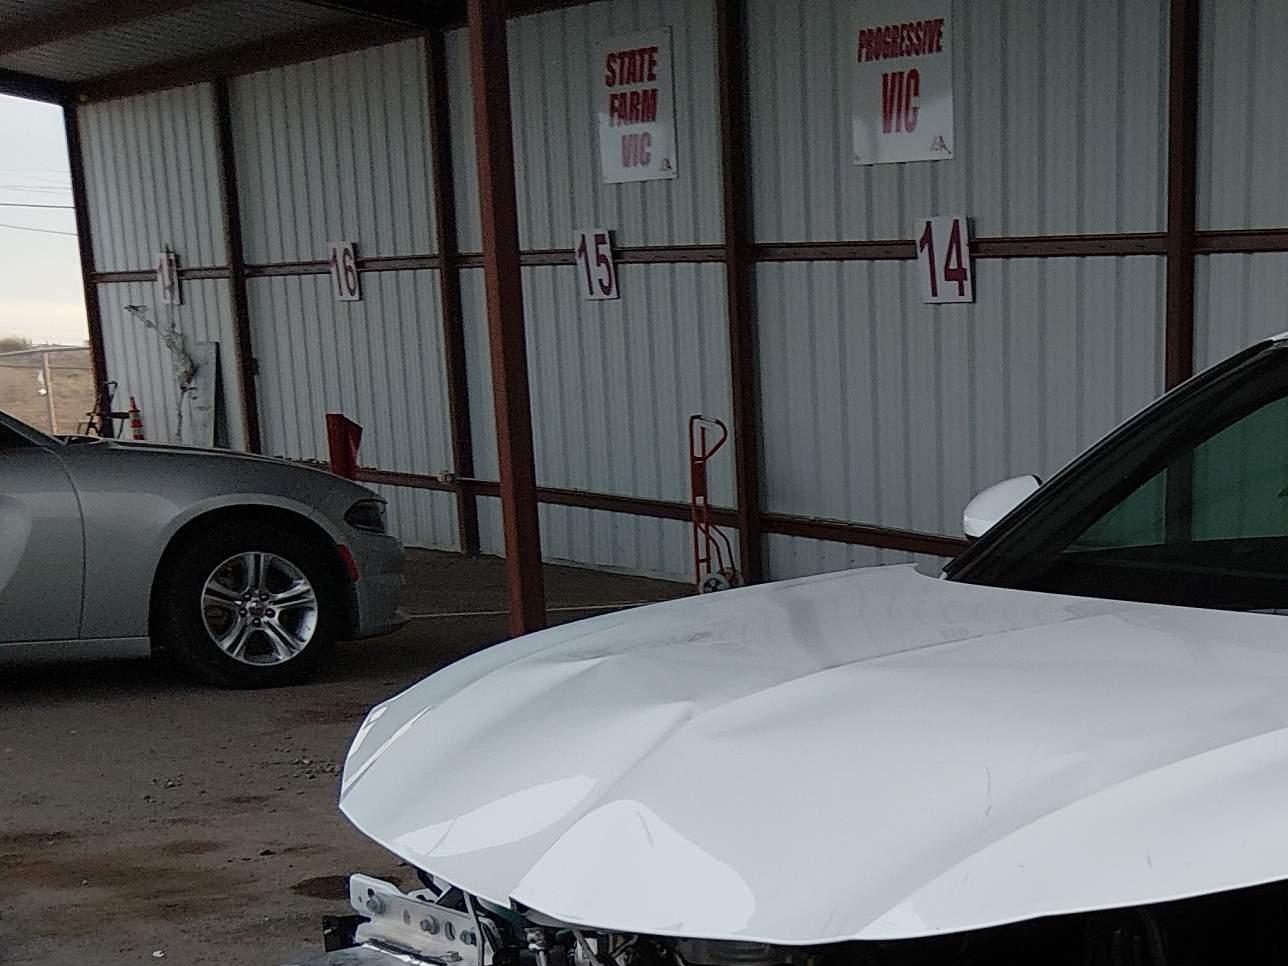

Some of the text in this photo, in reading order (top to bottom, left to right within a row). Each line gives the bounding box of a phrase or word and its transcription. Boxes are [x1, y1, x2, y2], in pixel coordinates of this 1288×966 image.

[857, 18, 945, 63] PROGRESSIVE
[605, 47, 658, 87] STATE
[609, 89, 658, 127] FARM
[882, 68, 921, 134] VIC
[622, 132, 652, 168] VIC
[330, 247, 357, 297] 16
[578, 233, 613, 295] 15
[919, 219, 968, 297] 14
